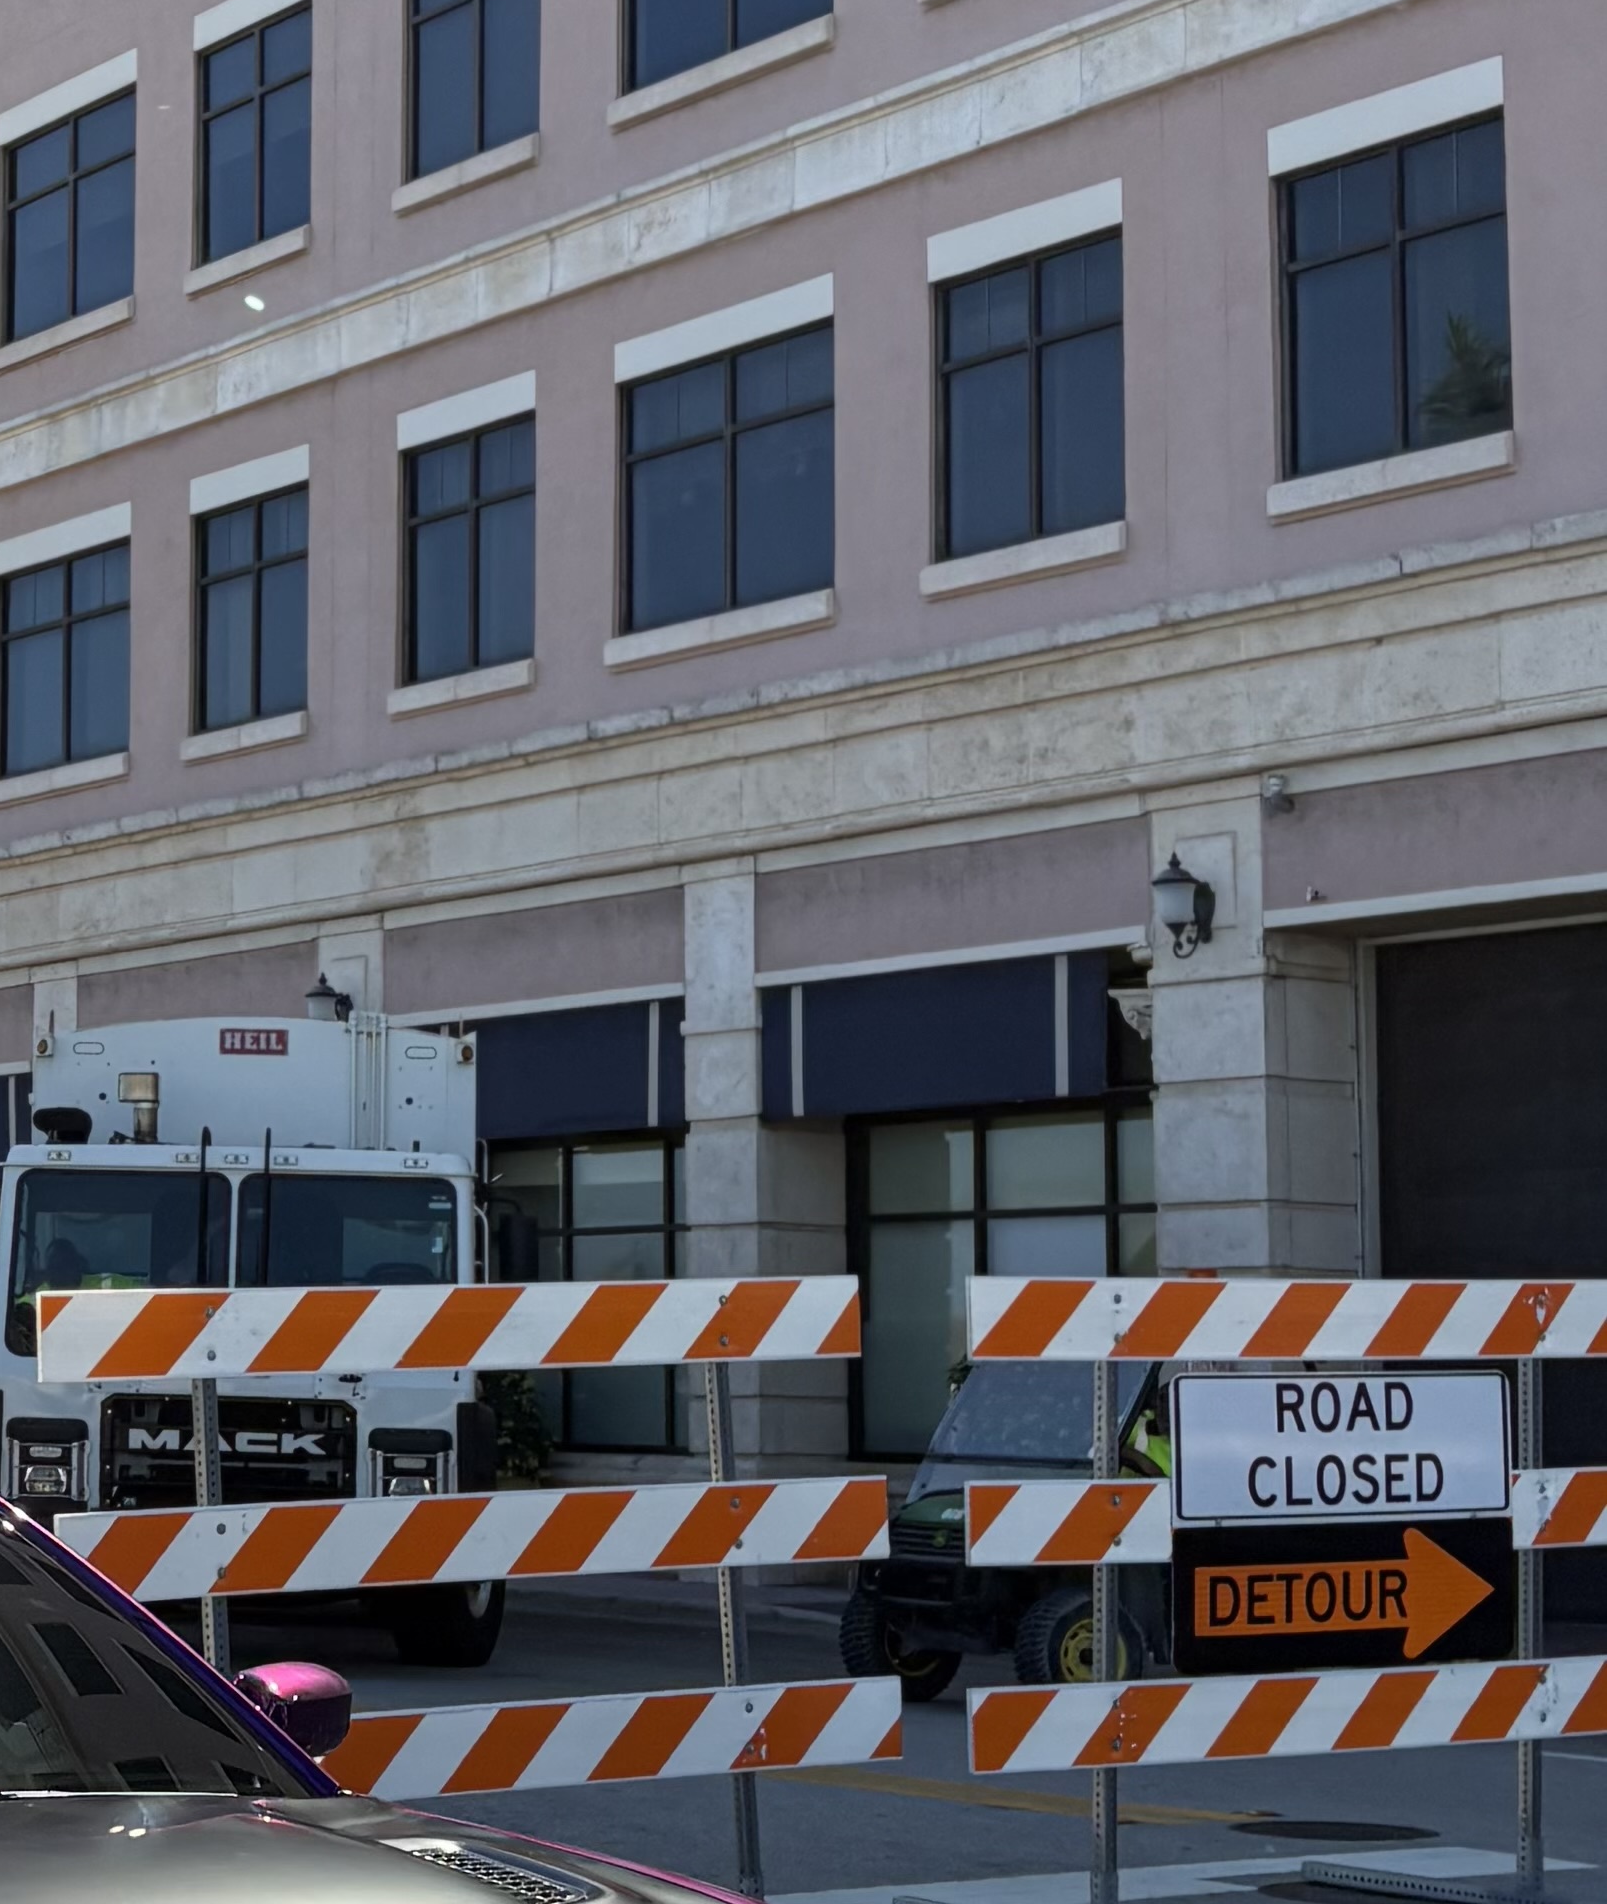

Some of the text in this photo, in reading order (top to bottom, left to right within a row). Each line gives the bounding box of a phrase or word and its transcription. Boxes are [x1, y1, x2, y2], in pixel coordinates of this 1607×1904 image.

[224, 1031, 283, 1051] HEIL
[1275, 1382, 1414, 1433] ROAD
[1248, 1453, 1444, 1507] CLOSED
[1208, 1569, 1408, 1627] DETOUR
